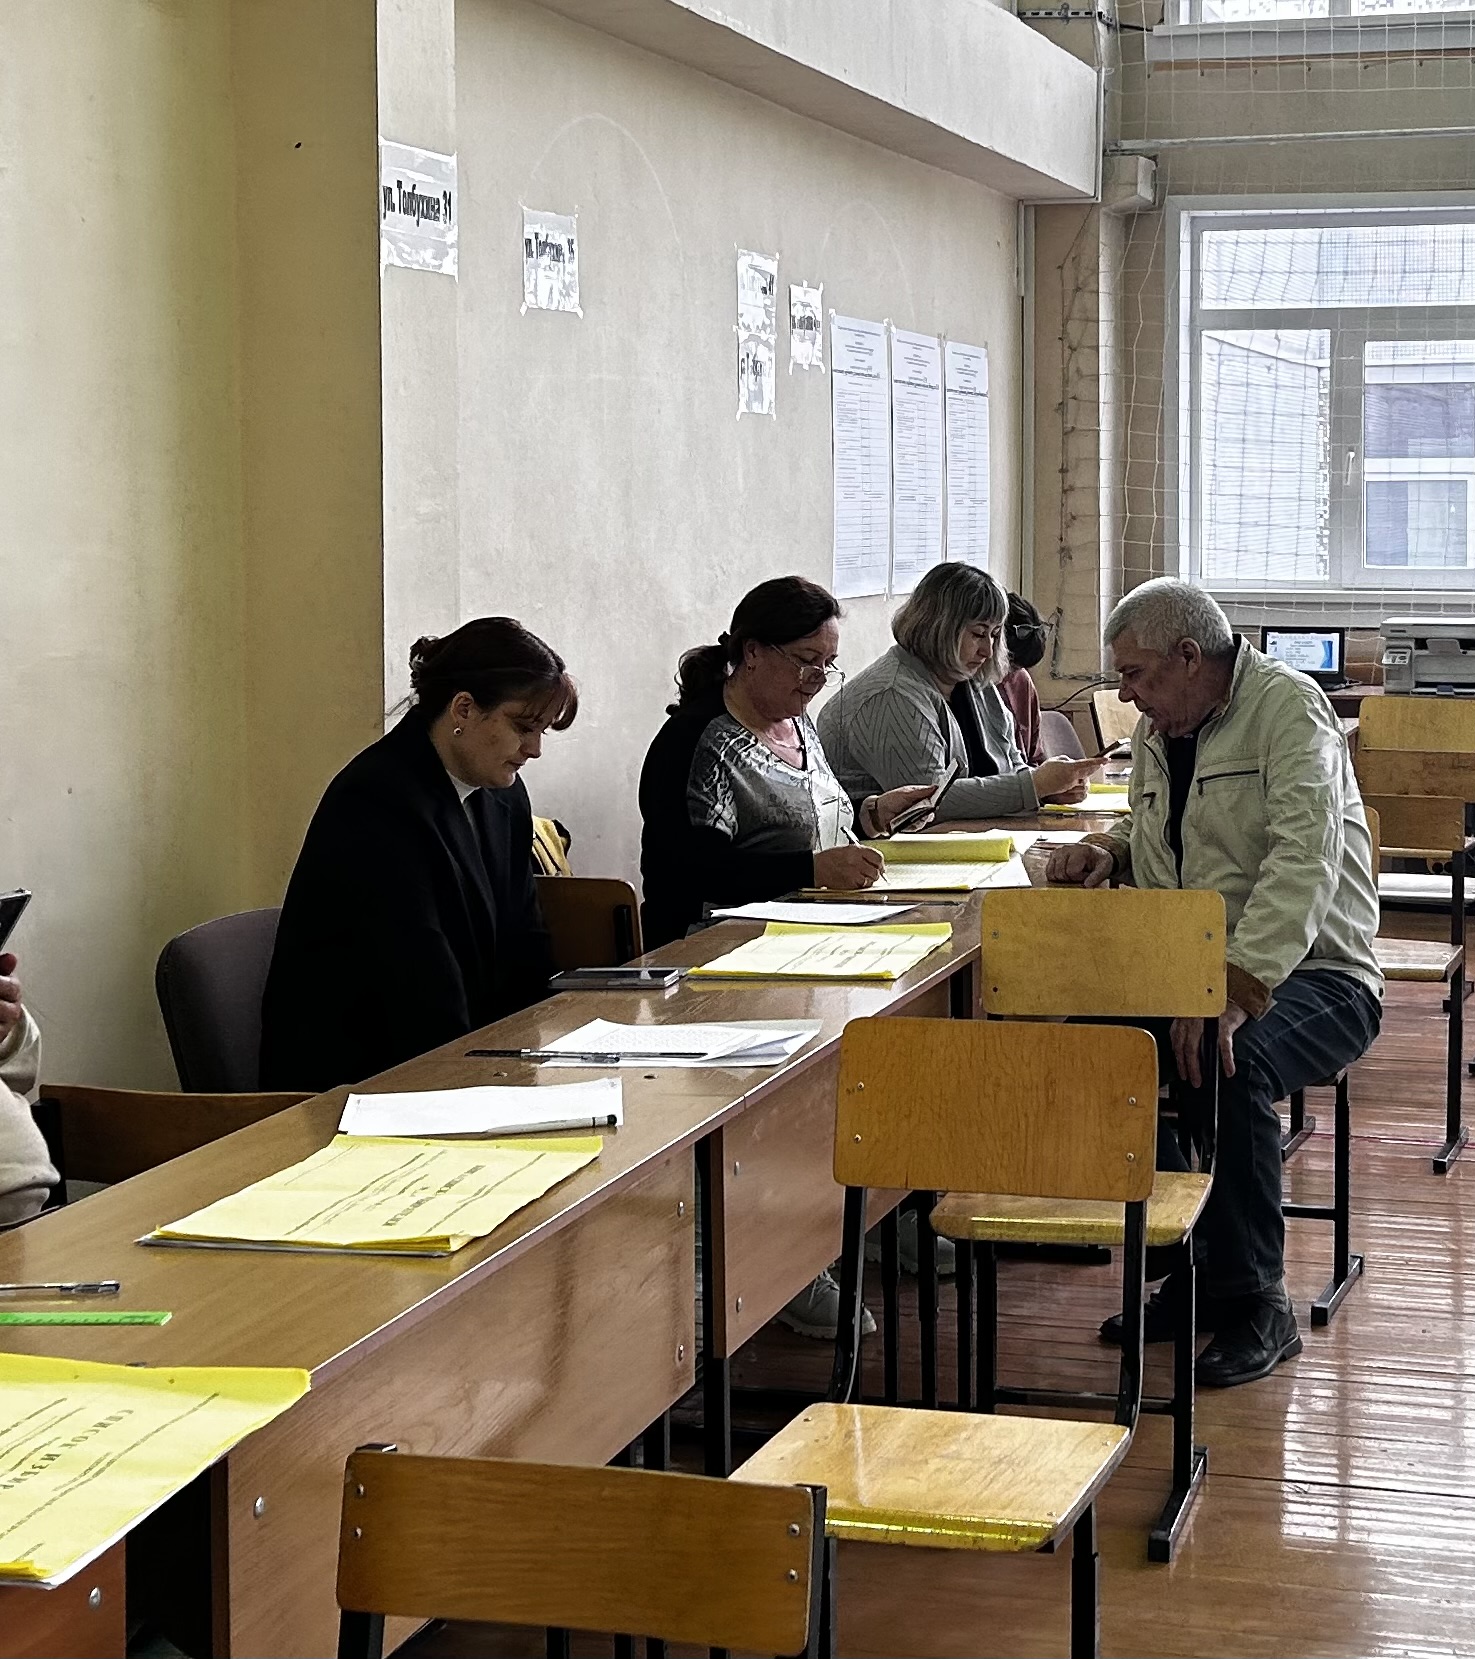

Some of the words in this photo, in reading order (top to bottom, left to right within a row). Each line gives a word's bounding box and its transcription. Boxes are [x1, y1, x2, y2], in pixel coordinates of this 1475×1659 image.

[383, 185, 395, 219] ул.
[397, 180, 441, 227] Толбухина
[443, 190, 452, 224] 31
